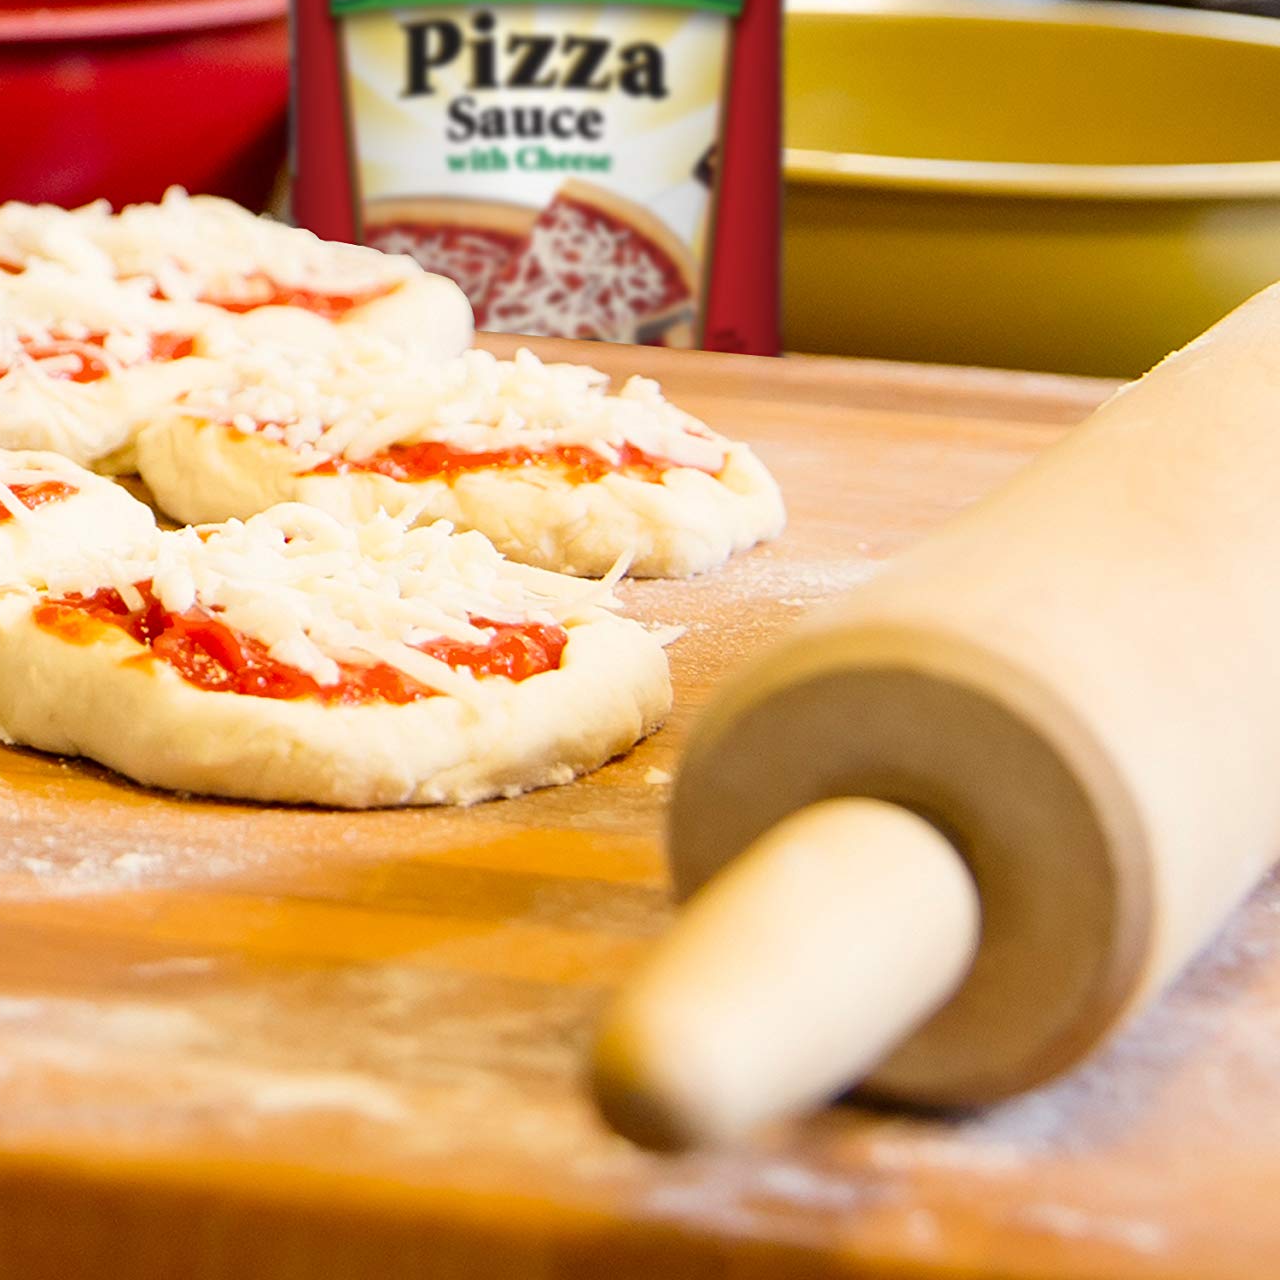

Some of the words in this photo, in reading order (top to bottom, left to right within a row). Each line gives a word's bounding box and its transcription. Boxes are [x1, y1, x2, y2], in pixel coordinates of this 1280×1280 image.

[400, 11, 670, 100] Pizza
[445, 96, 604, 143] Sauce
[446, 147, 509, 173] with
[515, 147, 613, 174] Cheese
